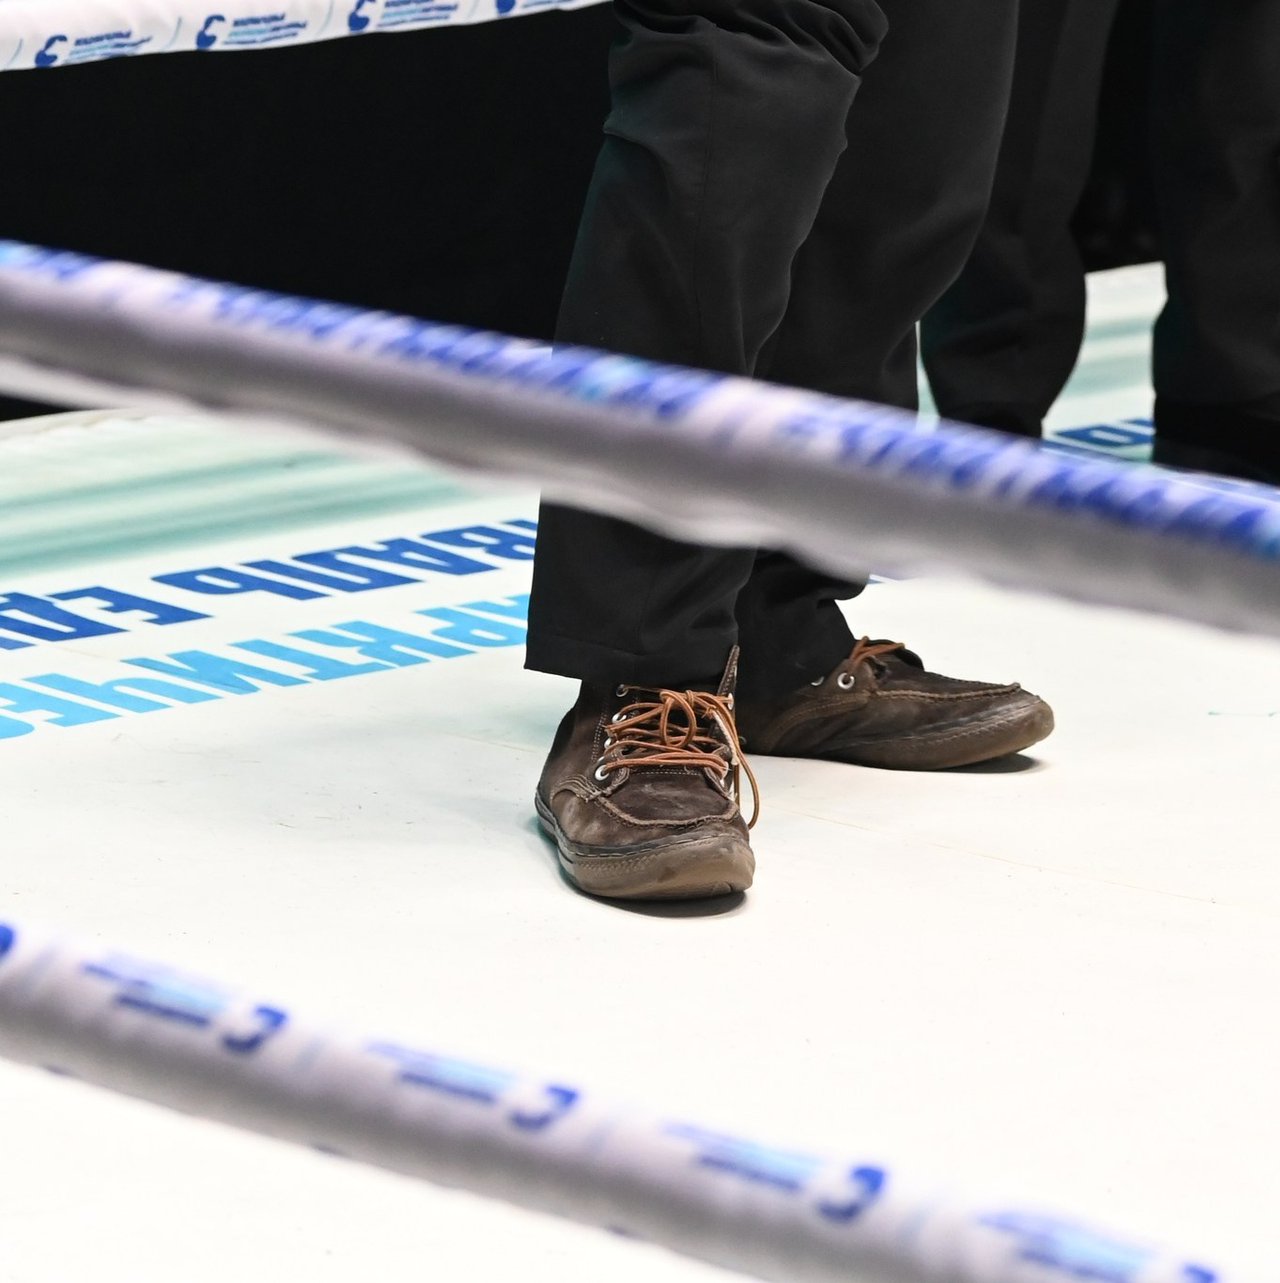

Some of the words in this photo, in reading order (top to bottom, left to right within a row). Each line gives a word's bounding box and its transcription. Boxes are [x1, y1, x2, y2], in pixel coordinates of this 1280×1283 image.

[150, 519, 537, 601] ВАЛЬ
[0, 586, 213, 651] ЕД
[0, 593, 530, 737] РКТИЧЕ
